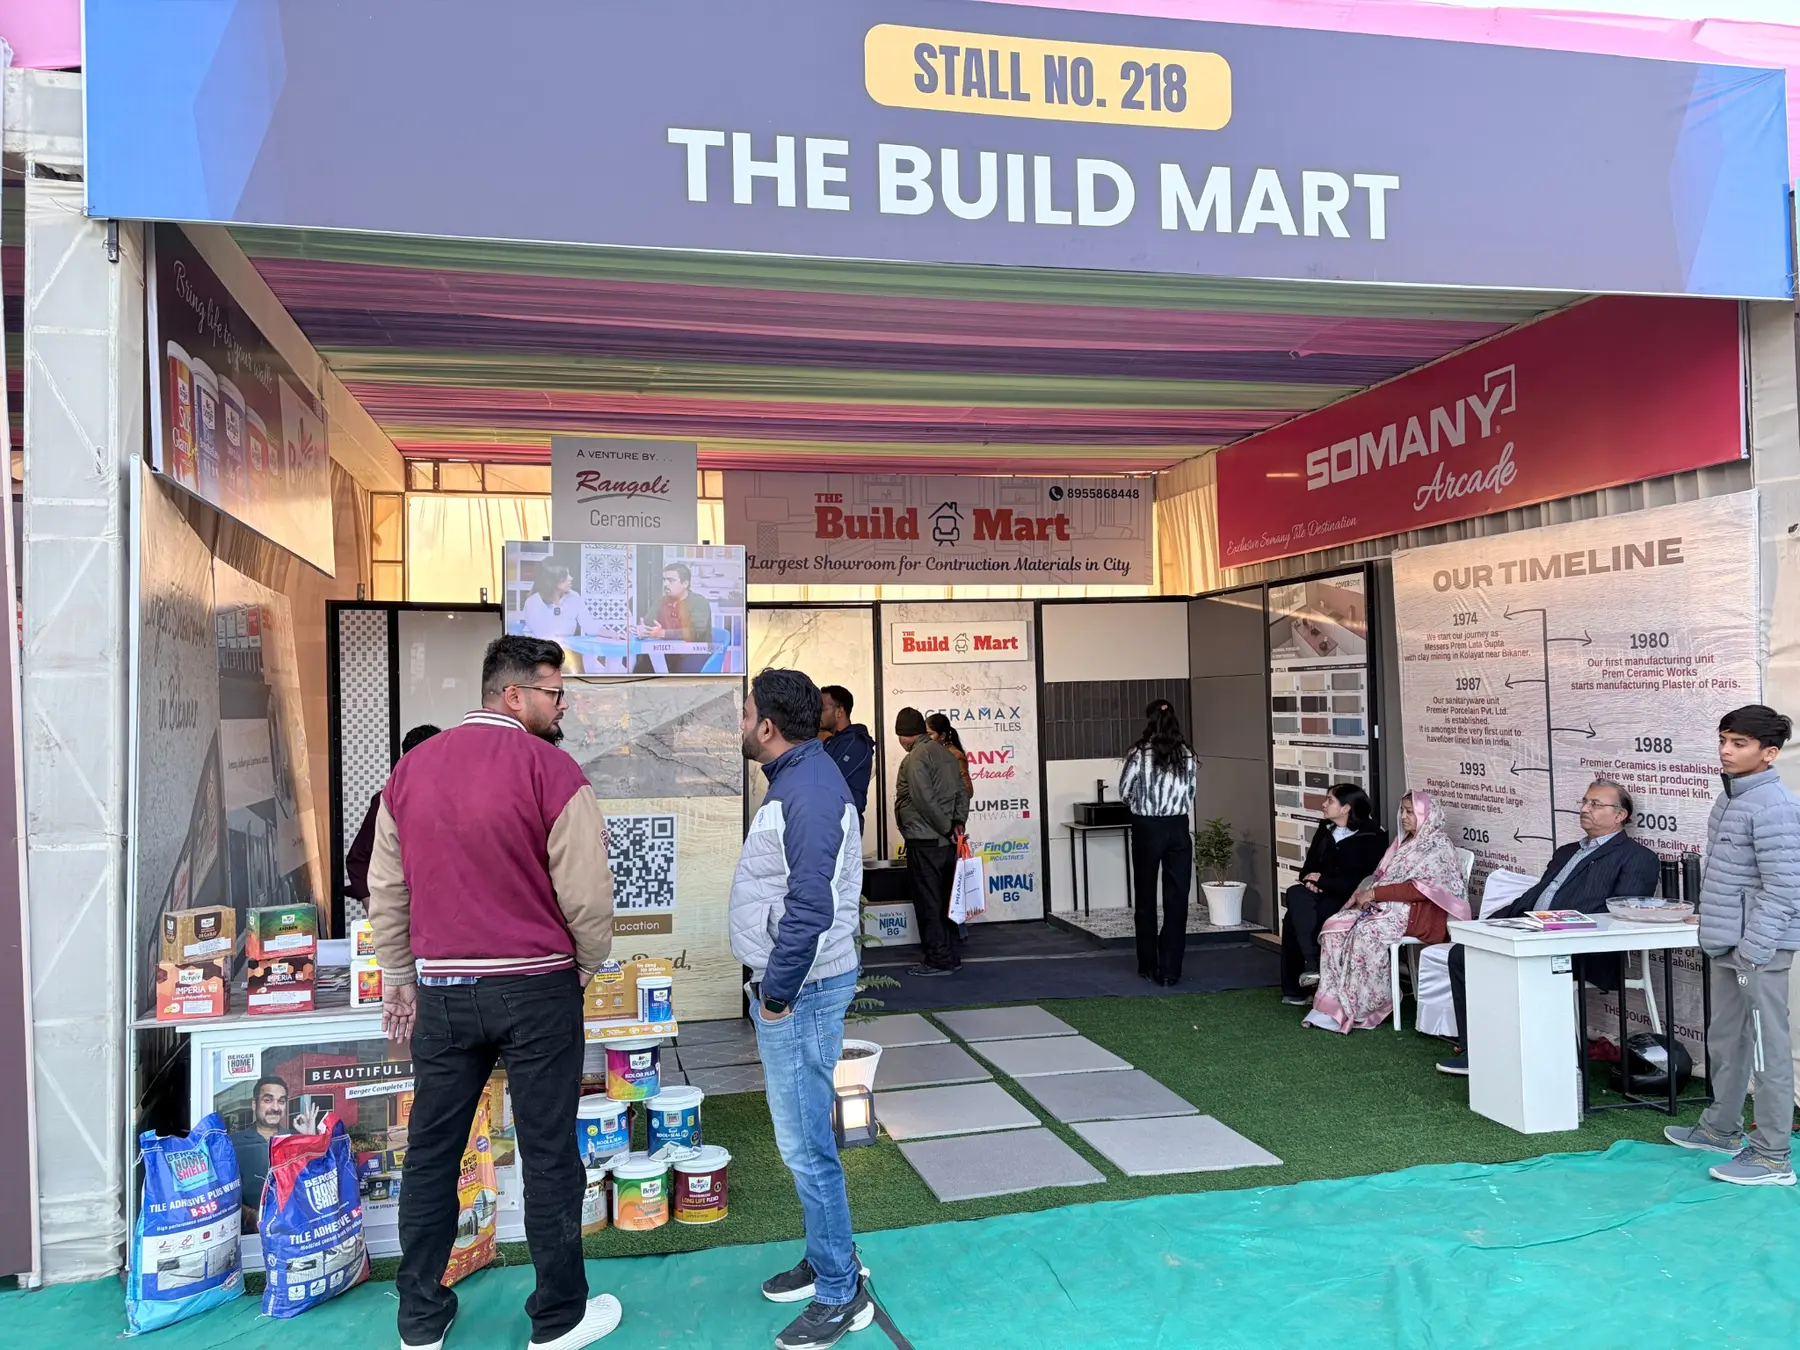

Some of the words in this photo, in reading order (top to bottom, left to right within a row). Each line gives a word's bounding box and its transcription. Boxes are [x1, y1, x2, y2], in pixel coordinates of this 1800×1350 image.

[914, 44, 1030, 103] STALL
[1044, 55, 1107, 108] NO.
[1120, 61, 1186, 112] 218
[668, 128, 850, 211] THE
[878, 142, 1135, 228] BUILD
[1160, 162, 1400, 240] MART
[174, 260, 206, 333] Bring
[208, 298, 223, 347] life
[253, 364, 273, 394] walls
[1307, 383, 1507, 491] SOMANY
[577, 450, 584, 458] A
[588, 451, 638, 460] VENTURE
[1413, 442, 1518, 511] Arcade
[576, 471, 669, 499] Rangoli
[815, 493, 842, 503] THE
[1067, 488, 1140, 499] 8955868448
[590, 510, 661, 528] Ceramics
[815, 506, 919, 539] Build
[973, 508, 1070, 541] Mart
[1227, 537, 1259, 556] Exclusive
[1260, 531, 1291, 549] Somany
[1308, 516, 1357, 537] Destination
[748, 555, 809, 573] Largest
[814, 556, 896, 571] Showroom
[897, 556, 919, 576] for
[925, 556, 1011, 571] Contruction
[1013, 556, 1082, 572] Materials
[1085, 558, 1100, 571] in
[1103, 558, 1131, 576] City
[1433, 564, 1493, 592] OUR
[1498, 537, 1684, 584] TIMELINE
[1453, 612, 1478, 626] 1974
[1465, 631, 1489, 640] journey
[1630, 632, 1669, 649] 1980
[903, 636, 949, 652] Build
[974, 635, 1018, 650] Mart
[1484, 640, 1504, 649] Gupta
[1418, 654, 1429, 662] clay
[1431, 653, 1450, 661] mining
[1460, 651, 1484, 660] Kolayat
[1588, 658, 1603, 667] Our
[1606, 657, 1622, 666] first
[1625, 655, 1691, 667] manufacturing
[1695, 654, 1714, 663] unit
[1602, 670, 1624, 678] Prem
[1627, 668, 1664, 677] Ceramic
[1667, 667, 1697, 676] Works
[1456, 678, 1480, 690] 1987
[1571, 681, 1593, 690] starts
[1596, 680, 1659, 691] manufacturing
[1662, 679, 1695, 689] Plaster
[1712, 678, 1740, 688] Paris.
[1433, 696, 1444, 704] Our
[1446, 696, 1485, 706] sanitaryware
[1426, 706, 1448, 714] Premier
[1451, 706, 1479, 714] Porcelain
[1481, 707, 1493, 715] Pvt.
[1496, 707, 1508, 715] Ltd.
[994, 722, 1021, 732] TILES
[1452, 717, 1489, 725] established.
[1431, 726, 1456, 735] amongst
[1458, 726, 1467, 734] the
[1469, 728, 1483, 736] very
[1485, 727, 1498, 735] first
[1493, 738, 1511, 746] India.
[1635, 737, 1672, 754] 1988
[1460, 762, 1485, 776] 1993
[1580, 758, 1612, 768] Premier
[1615, 760, 1656, 771] Ceramics
[972, 766, 1015, 780] Arcade
[1594, 770, 1619, 780] where
[1622, 772, 1634, 780] we
[1637, 774, 1657, 782] start
[1660, 775, 1708, 789] producing
[1427, 778, 1449, 788] Rangoli
[1451, 780, 1479, 791] Ceramics
[1481, 784, 1493, 792] Pvt.
[1495, 786, 1508, 794] Ltd.
[1628, 785, 1646, 793] tiles
[1660, 788, 1689, 797] tunnel
[1693, 789, 1712, 800] kiln.
[1465, 793, 1504, 804] manufacture
[1506, 797, 1523, 807] large
[1461, 802, 1485, 812] ceramic
[1487, 806, 1503, 814] tiles.
[1637, 813, 1677, 832] 2003
[1463, 827, 1489, 843] 2016
[1658, 838, 1688, 852] facility
[1691, 844, 1700, 853] at
[1485, 850, 1509, 861] Limited
[1511, 854, 1517, 863] is
[1003, 892, 1020, 902] BG
[614, 921, 659, 931] Location
[268, 974, 292, 982] IMPERIA
[176, 986, 206, 994] IMPERIA
[231, 1058, 251, 1067] HOME
[312, 1065, 402, 1081] BEAUTIFUL
[349, 1087, 371, 1096] Berger
[372, 1083, 403, 1092] Complete
[177, 1162, 207, 1181] SHIELD
[150, 1203, 167, 1213] TILE
[207, 1187, 222, 1199] PLUS
[224, 1179, 241, 1193] WHITE
[191, 1201, 217, 1217] B-315
[290, 1232, 312, 1245] TILE
[314, 1214, 350, 1239] ADHESIVE
